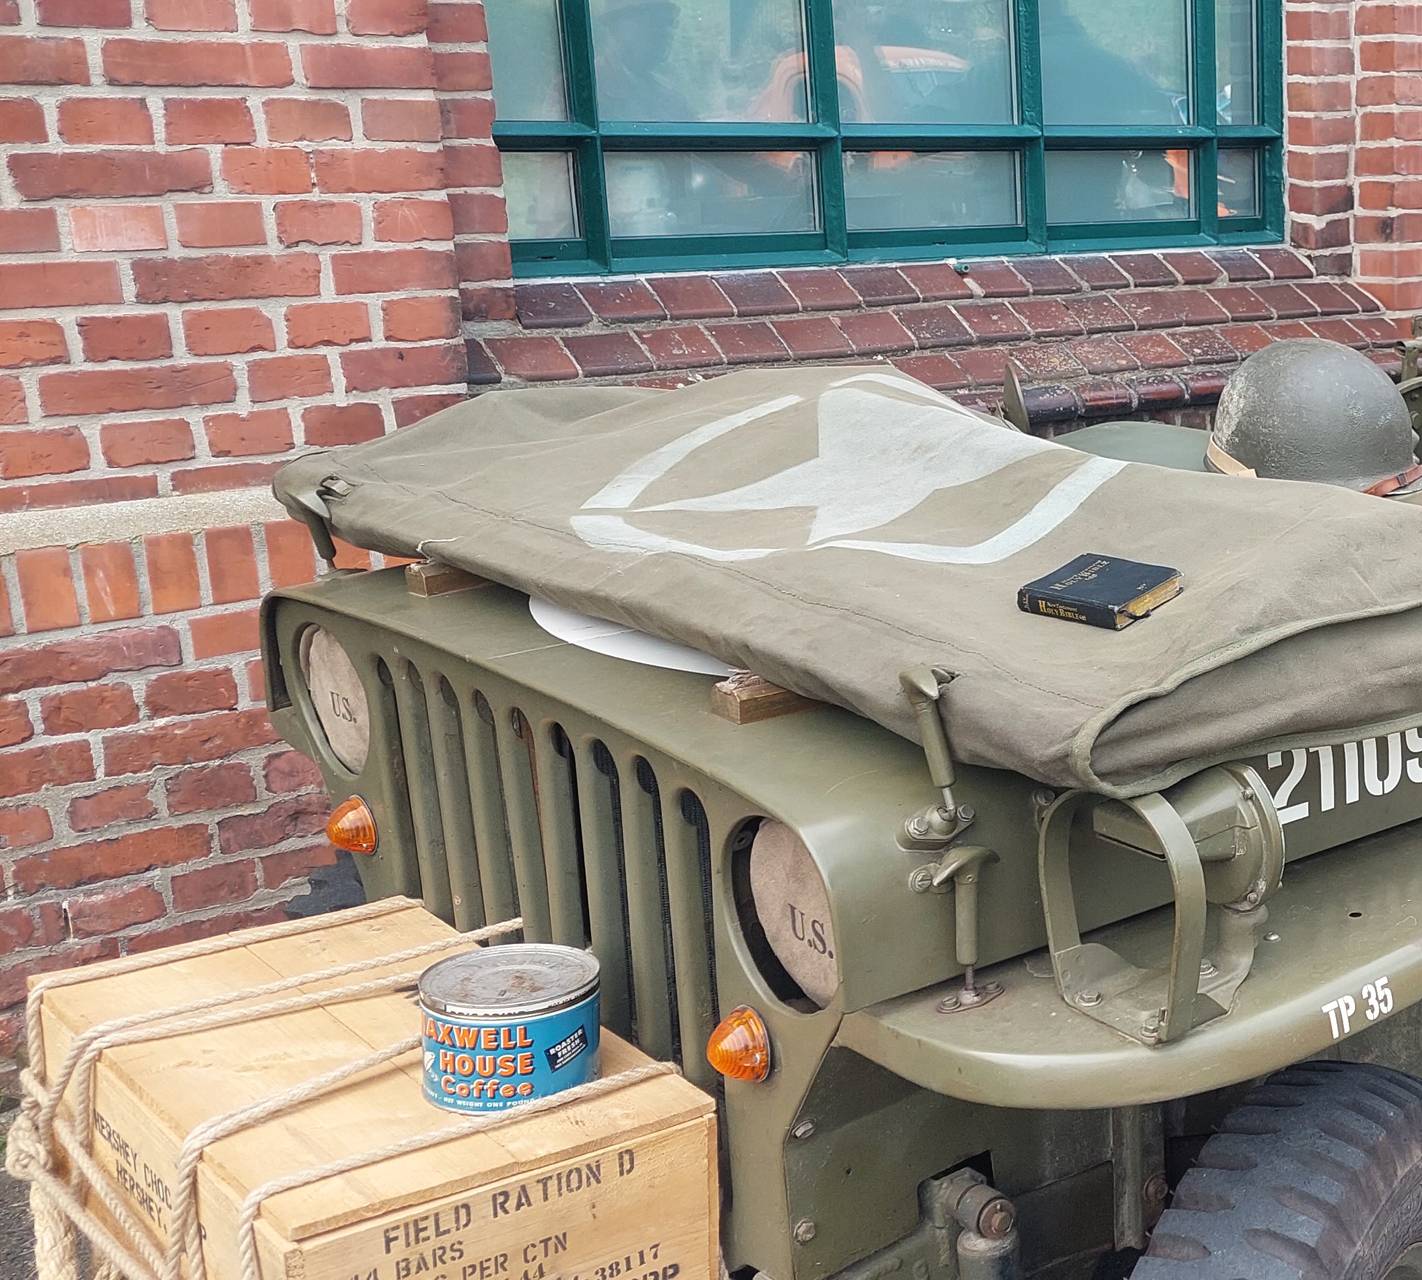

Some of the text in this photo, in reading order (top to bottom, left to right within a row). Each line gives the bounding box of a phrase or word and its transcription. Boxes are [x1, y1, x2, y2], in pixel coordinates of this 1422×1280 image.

[329, 690, 358, 724] U.S.
[787, 902, 834, 960] U.S.
[1320, 975, 1394, 1040] TP 35
[424, 1017, 535, 1050] AXWELL
[549, 1028, 584, 1055] ROASTER
[439, 1049, 536, 1077] HOUSE
[440, 1075, 535, 1098] Coffee
[93, 1107, 173, 1210] HERSHEY CHOC
[383, 1148, 636, 1255] FIELD RATION D
[395, 1239, 465, 1280] BARS
[462, 1231, 568, 1280] PER CTN
